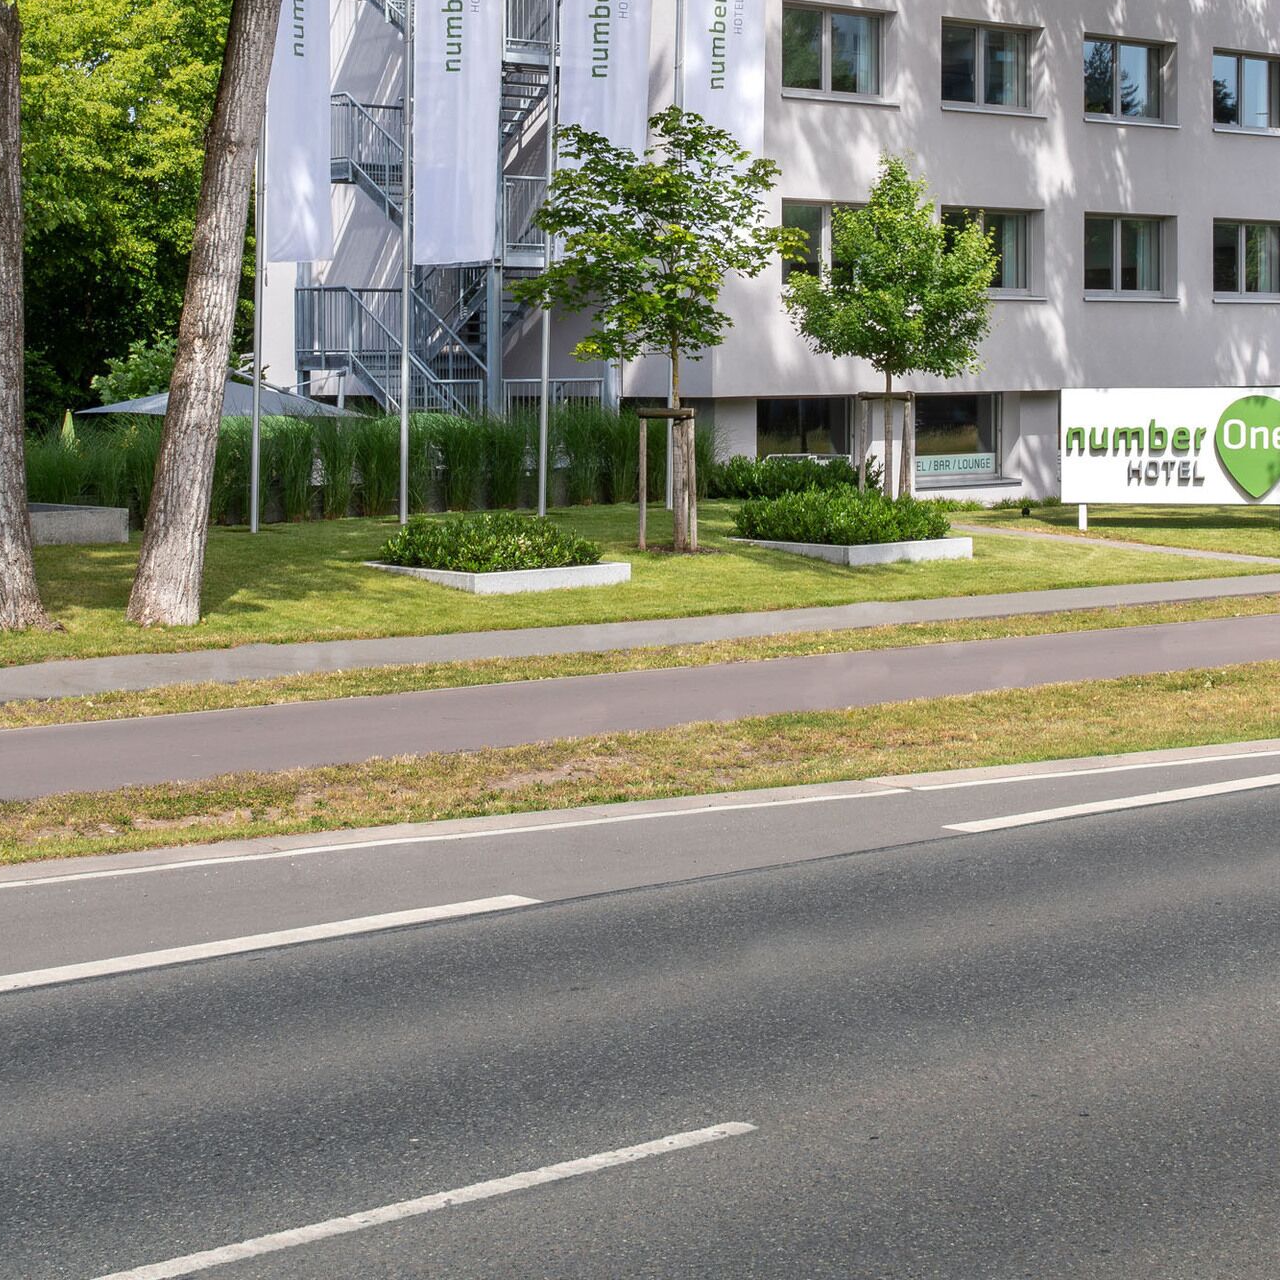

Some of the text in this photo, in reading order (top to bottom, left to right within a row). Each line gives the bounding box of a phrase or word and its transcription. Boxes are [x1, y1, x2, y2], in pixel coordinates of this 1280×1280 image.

[1066, 418, 1207, 452] number
[916, 460, 926, 472] EL
[933, 459, 951, 471] BAR
[957, 458, 991, 470] LOUNGE
[1127, 460, 1205, 485] HOTEL
